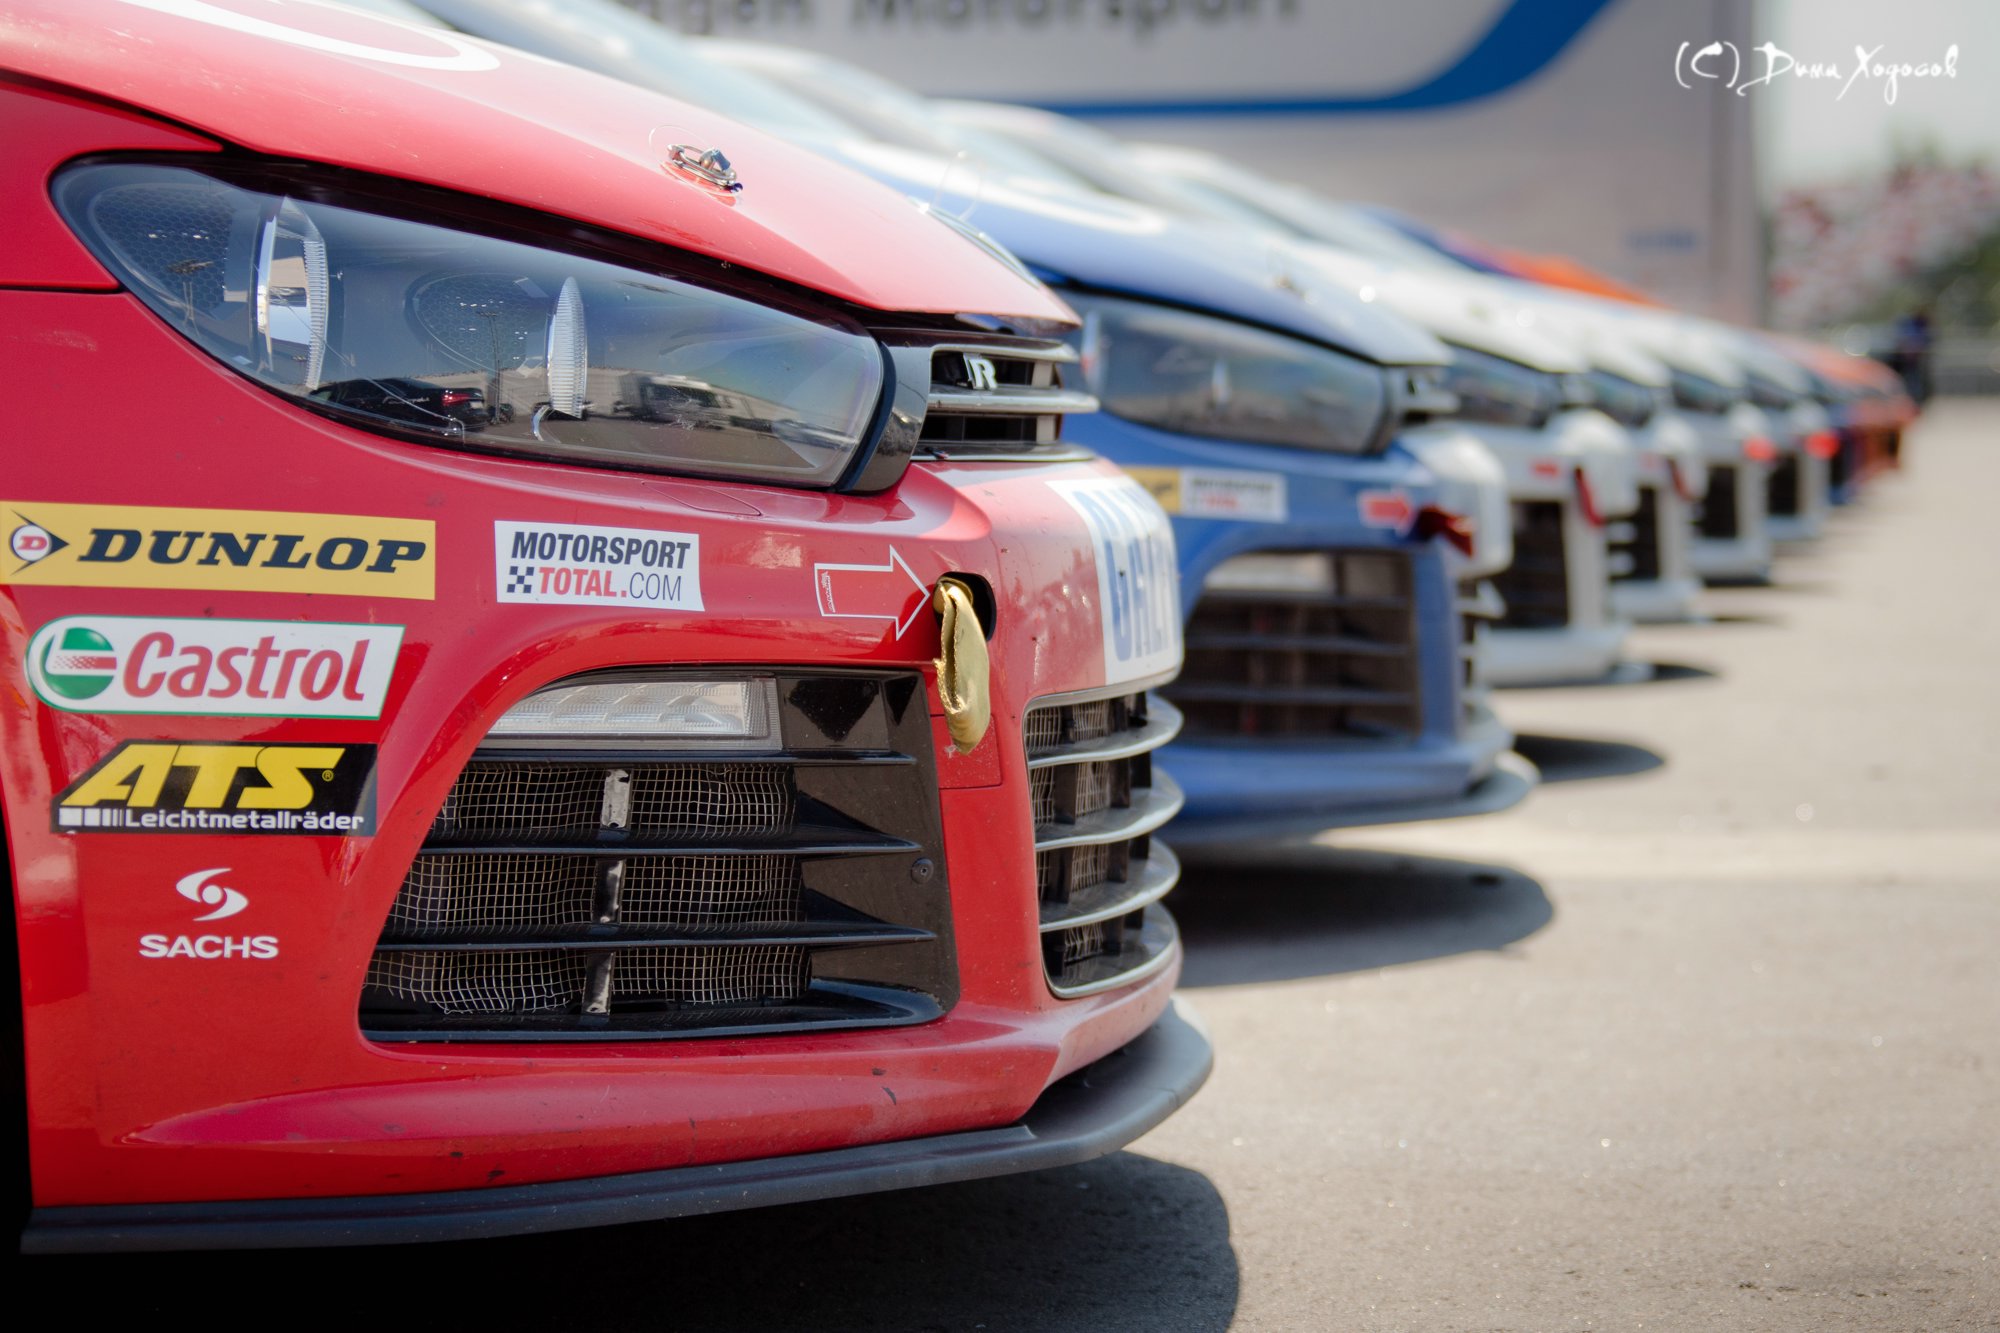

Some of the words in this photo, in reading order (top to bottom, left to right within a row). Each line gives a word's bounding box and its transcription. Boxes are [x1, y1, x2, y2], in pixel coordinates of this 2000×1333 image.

[77, 528, 427, 573] DUNLOP
[511, 531, 691, 569] MOTORSPORT
[122, 631, 371, 702] Castrol
[125, 808, 365, 830] Leichtmetallräder
[138, 933, 279, 959] SACHS
